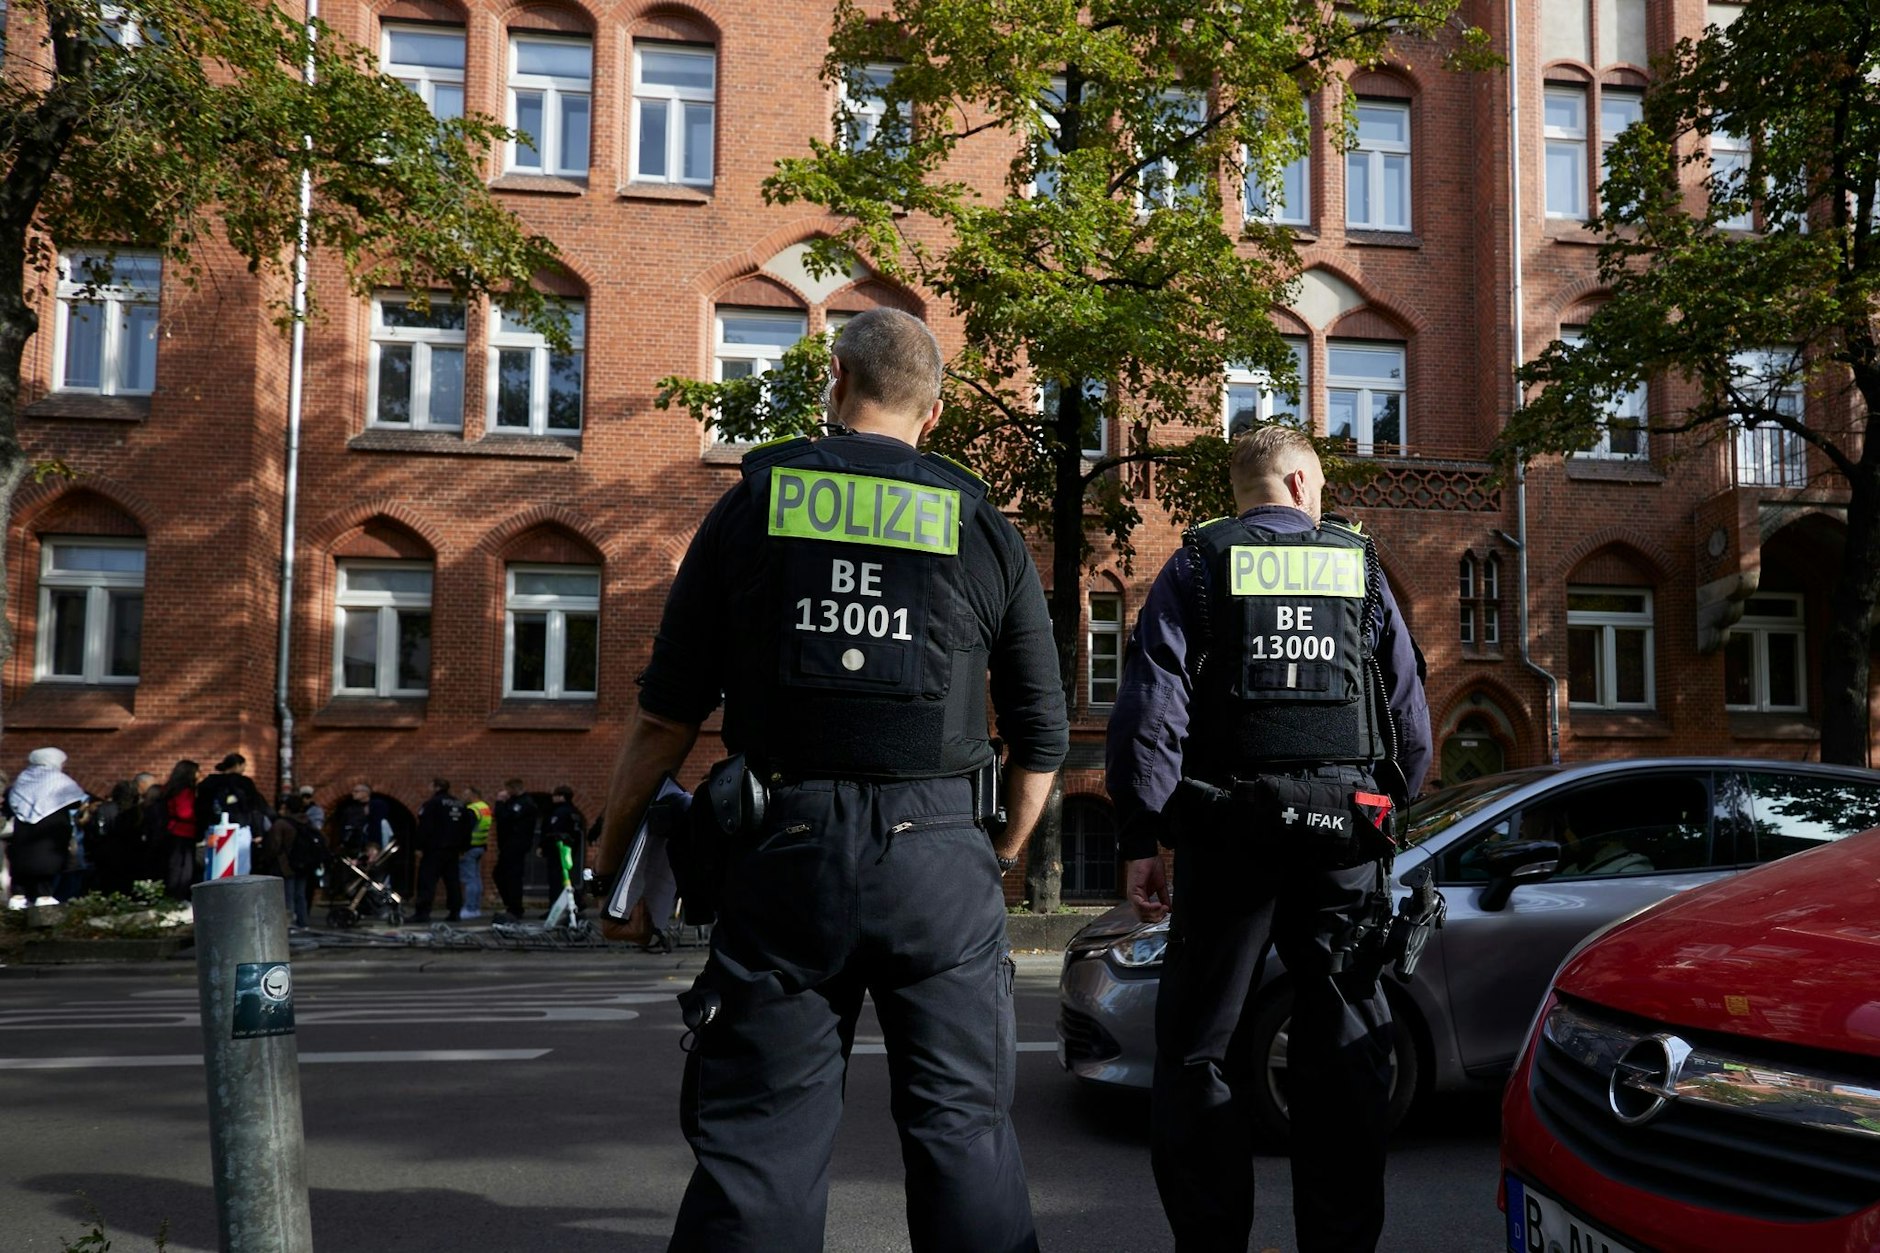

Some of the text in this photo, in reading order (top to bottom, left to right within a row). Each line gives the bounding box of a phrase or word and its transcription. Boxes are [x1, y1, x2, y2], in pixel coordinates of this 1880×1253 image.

[775, 474, 953, 548] POLIZEI
[831, 558, 883, 597] BE
[1235, 550, 1360, 592] POLIZEI
[795, 597, 913, 641] 13001
[1276, 606, 1313, 631] BE
[1252, 635, 1336, 661] 13000
[1306, 812, 1345, 831] IFAK
